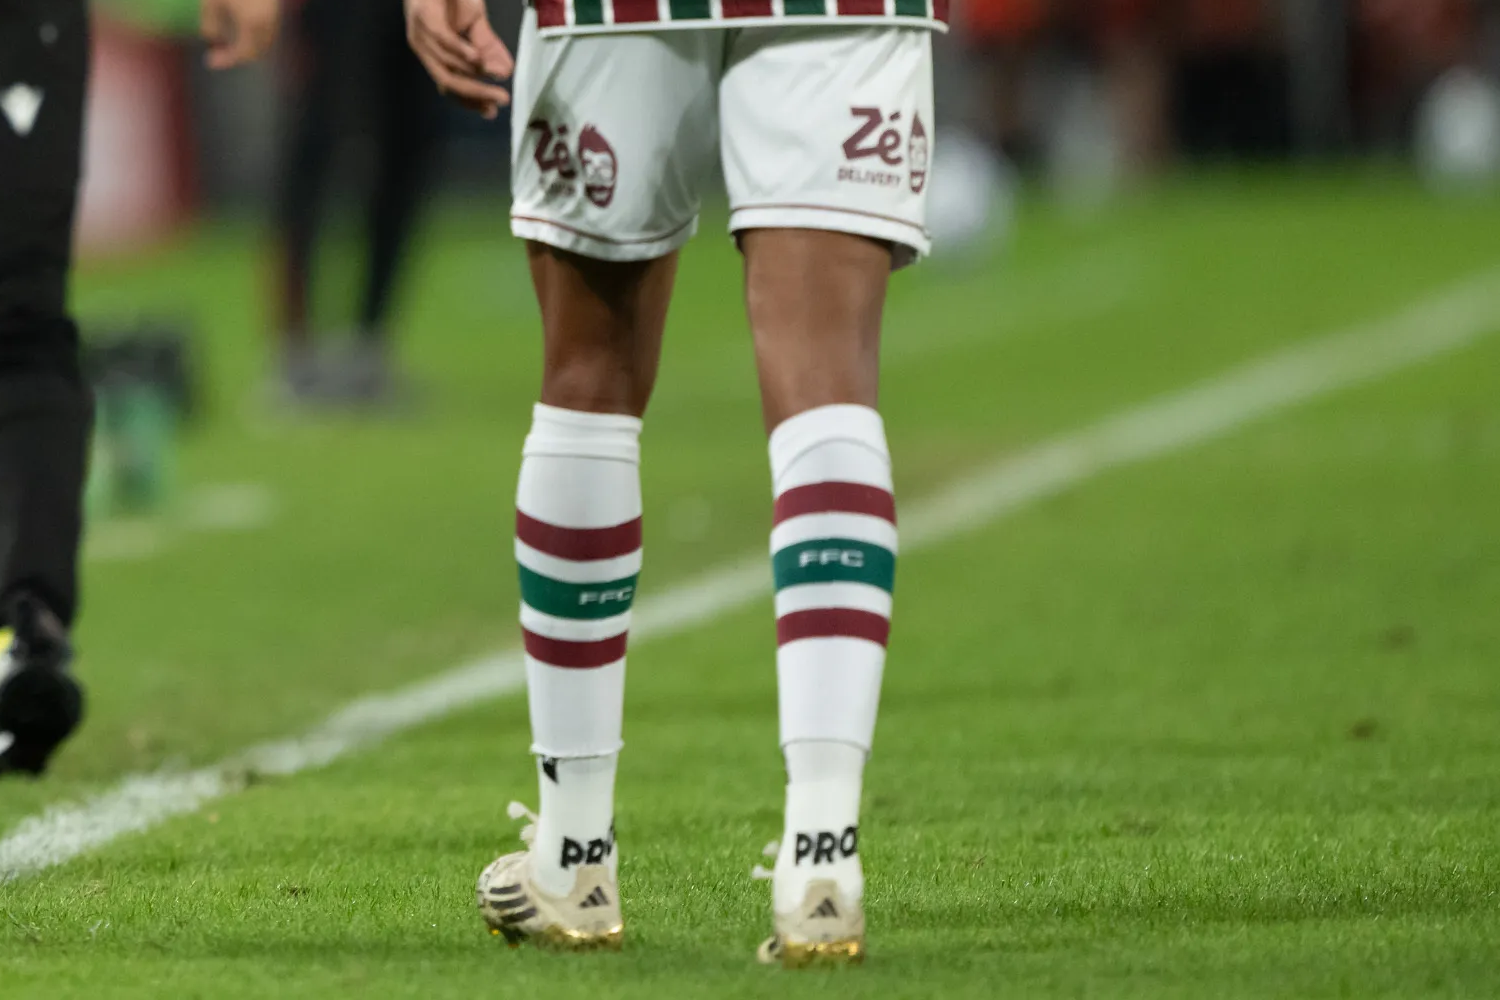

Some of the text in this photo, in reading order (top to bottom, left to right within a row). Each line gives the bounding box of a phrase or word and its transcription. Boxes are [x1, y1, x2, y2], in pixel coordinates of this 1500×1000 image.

[841, 106, 903, 166] Zé
[837, 167, 902, 187] DELIVERY
[799, 548, 864, 568] FFC
[579, 585, 634, 605] FFC
